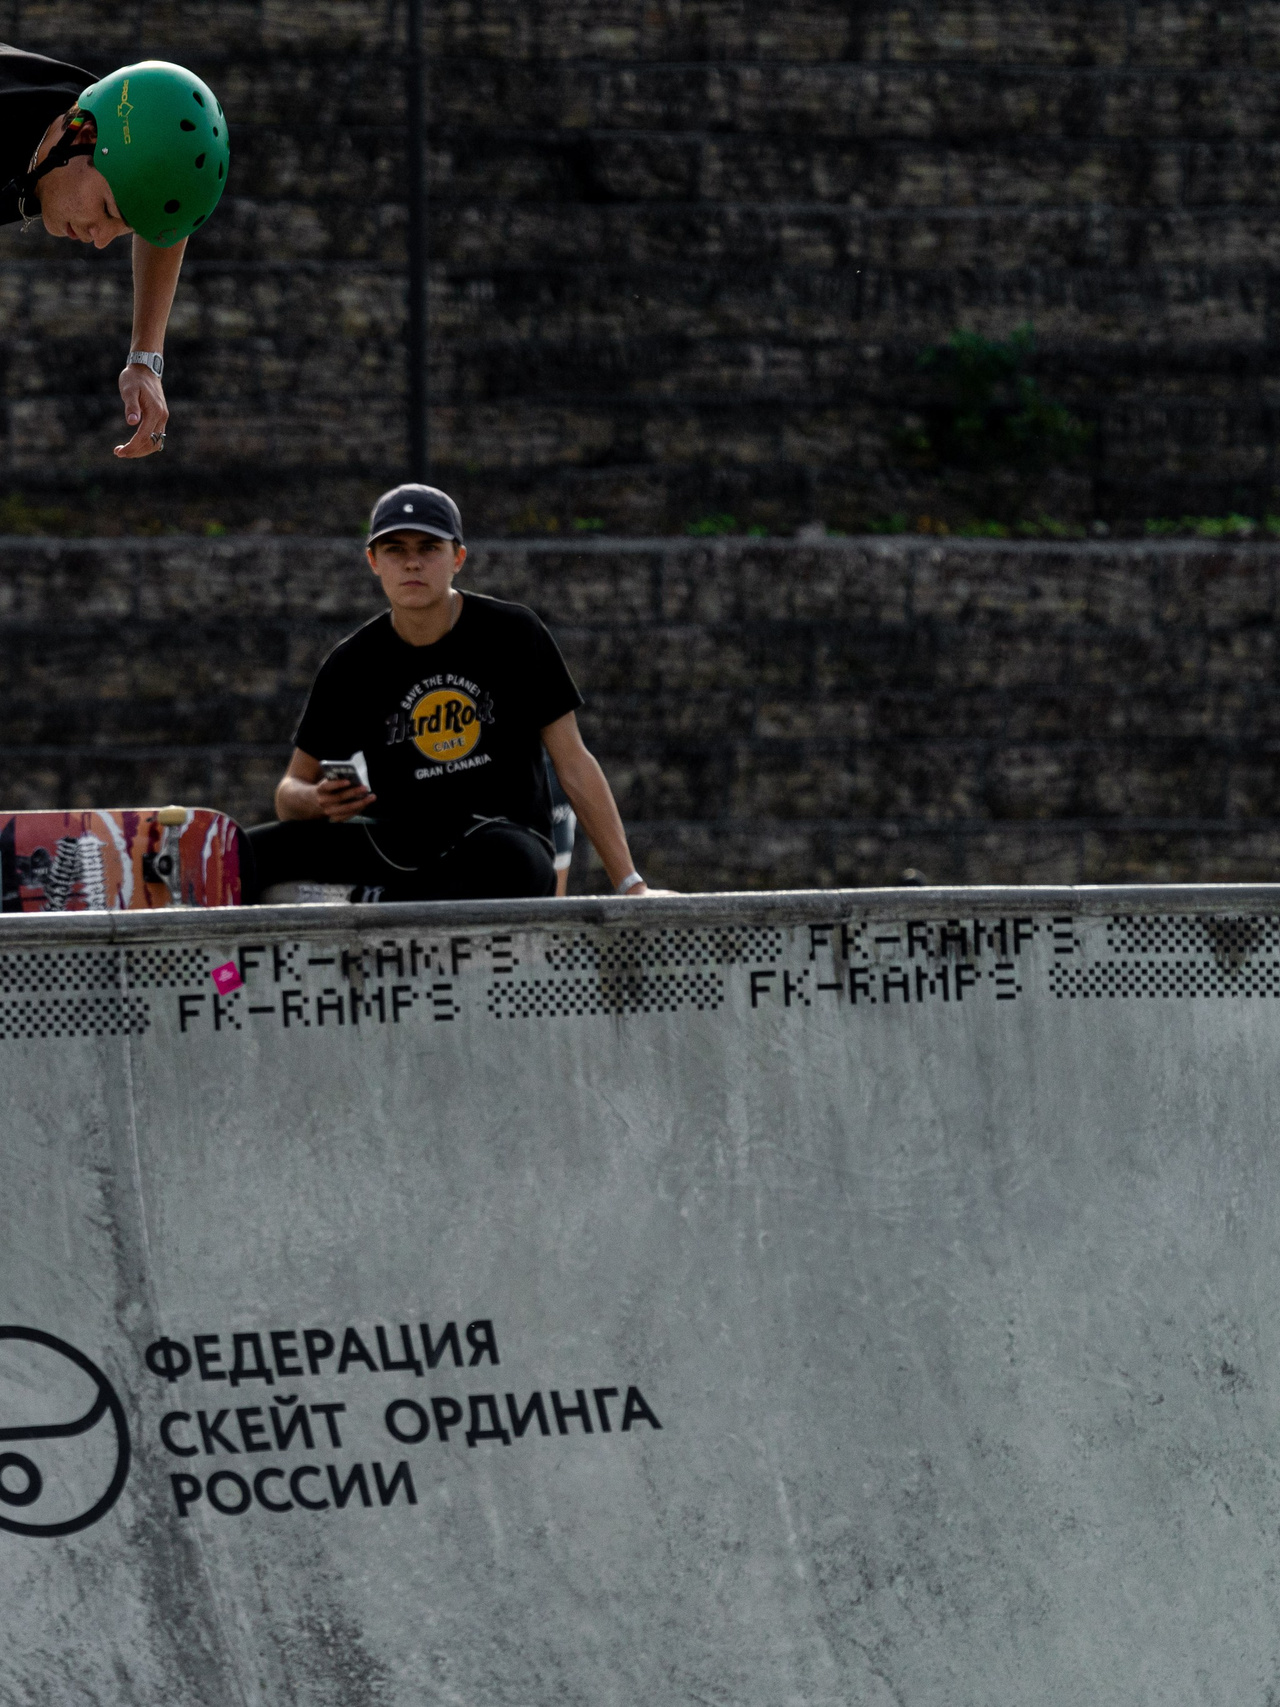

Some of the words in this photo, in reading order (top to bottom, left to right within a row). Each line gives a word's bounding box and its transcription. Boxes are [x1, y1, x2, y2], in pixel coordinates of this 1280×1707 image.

[400, 684, 424, 710] SAVE
[421, 674, 443, 688] THE
[446, 673, 481, 697] PLANET
[385, 704, 442, 745] Hard
[433, 736, 466, 752] CAFE
[414, 765, 443, 780] GRAN
[446, 753, 492, 773] CANARIA
[144, 1319, 501, 1387] ФЕДЕРАЦИЯ
[384, 1386, 663, 1448] ОРДИНГА
[169, 1461, 420, 1517] РОССИИ
